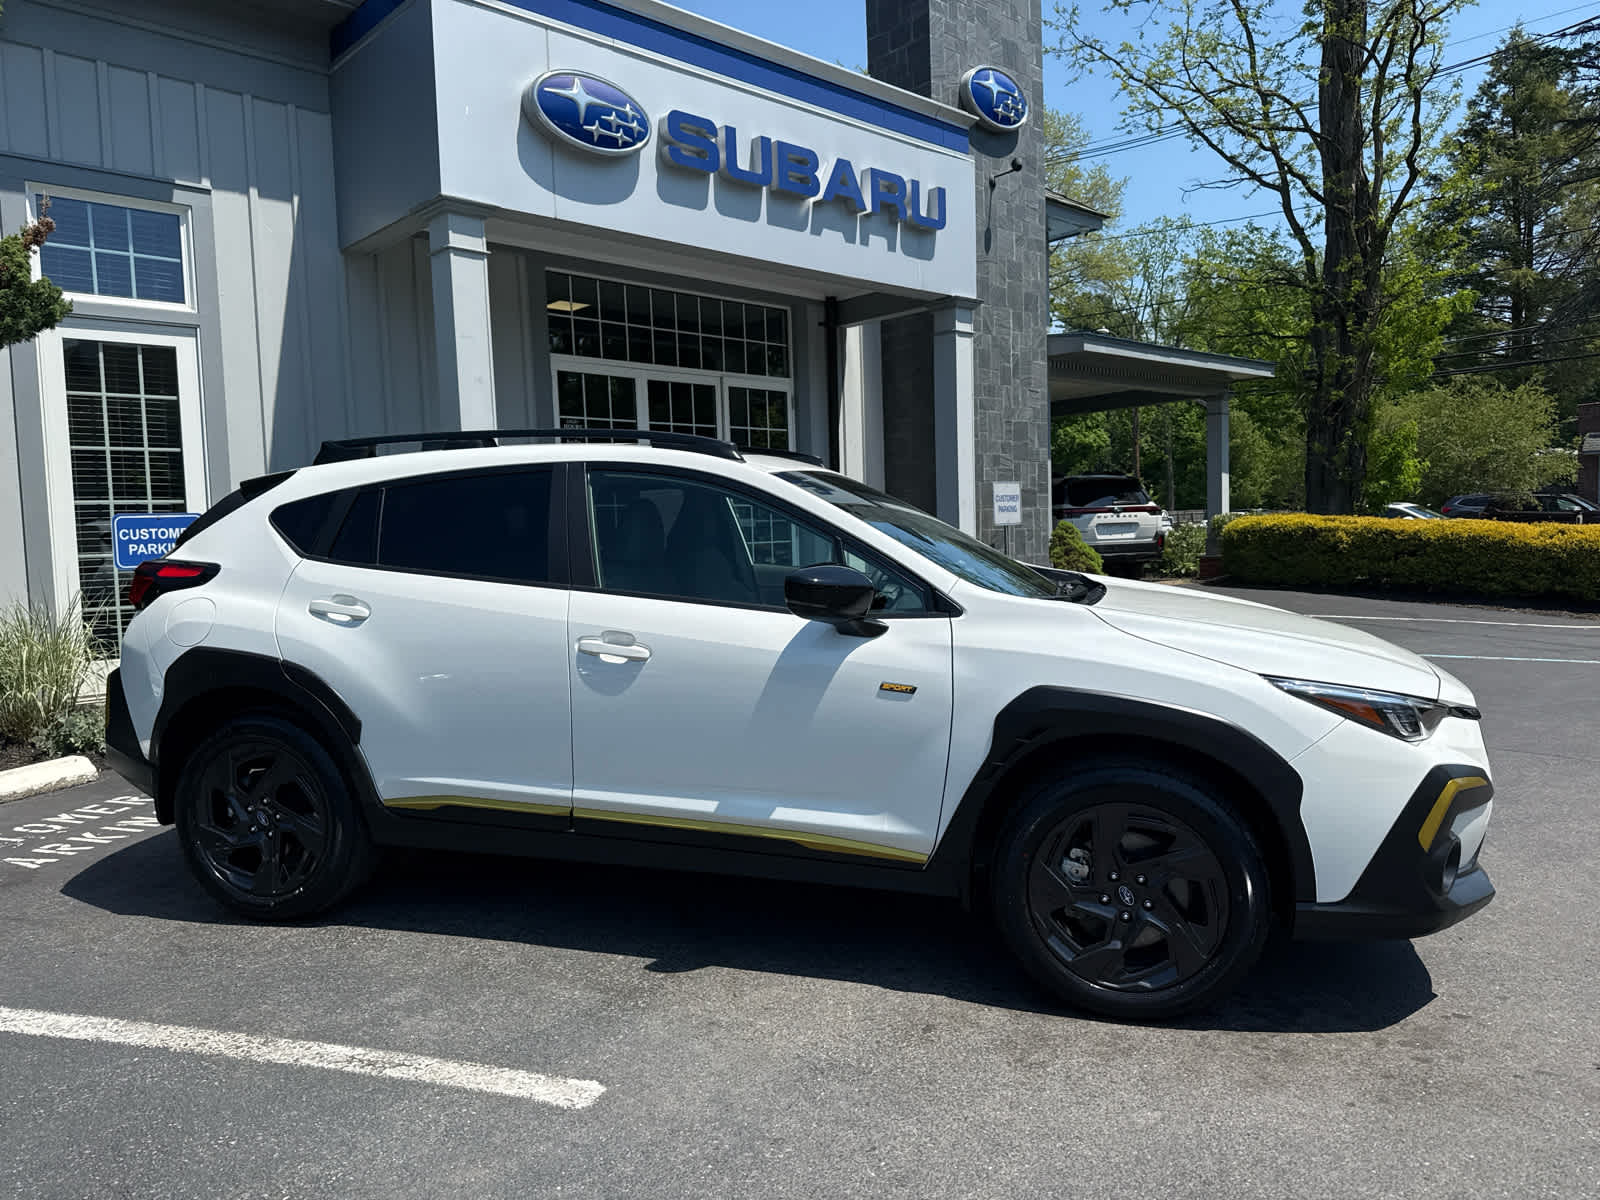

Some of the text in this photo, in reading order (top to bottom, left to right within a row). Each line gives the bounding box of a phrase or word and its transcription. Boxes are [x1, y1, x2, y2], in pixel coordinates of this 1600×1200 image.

[658, 109, 947, 231] SUBARU
[128, 542, 176, 556] PARKI
[881, 682, 914, 693] SPORT
